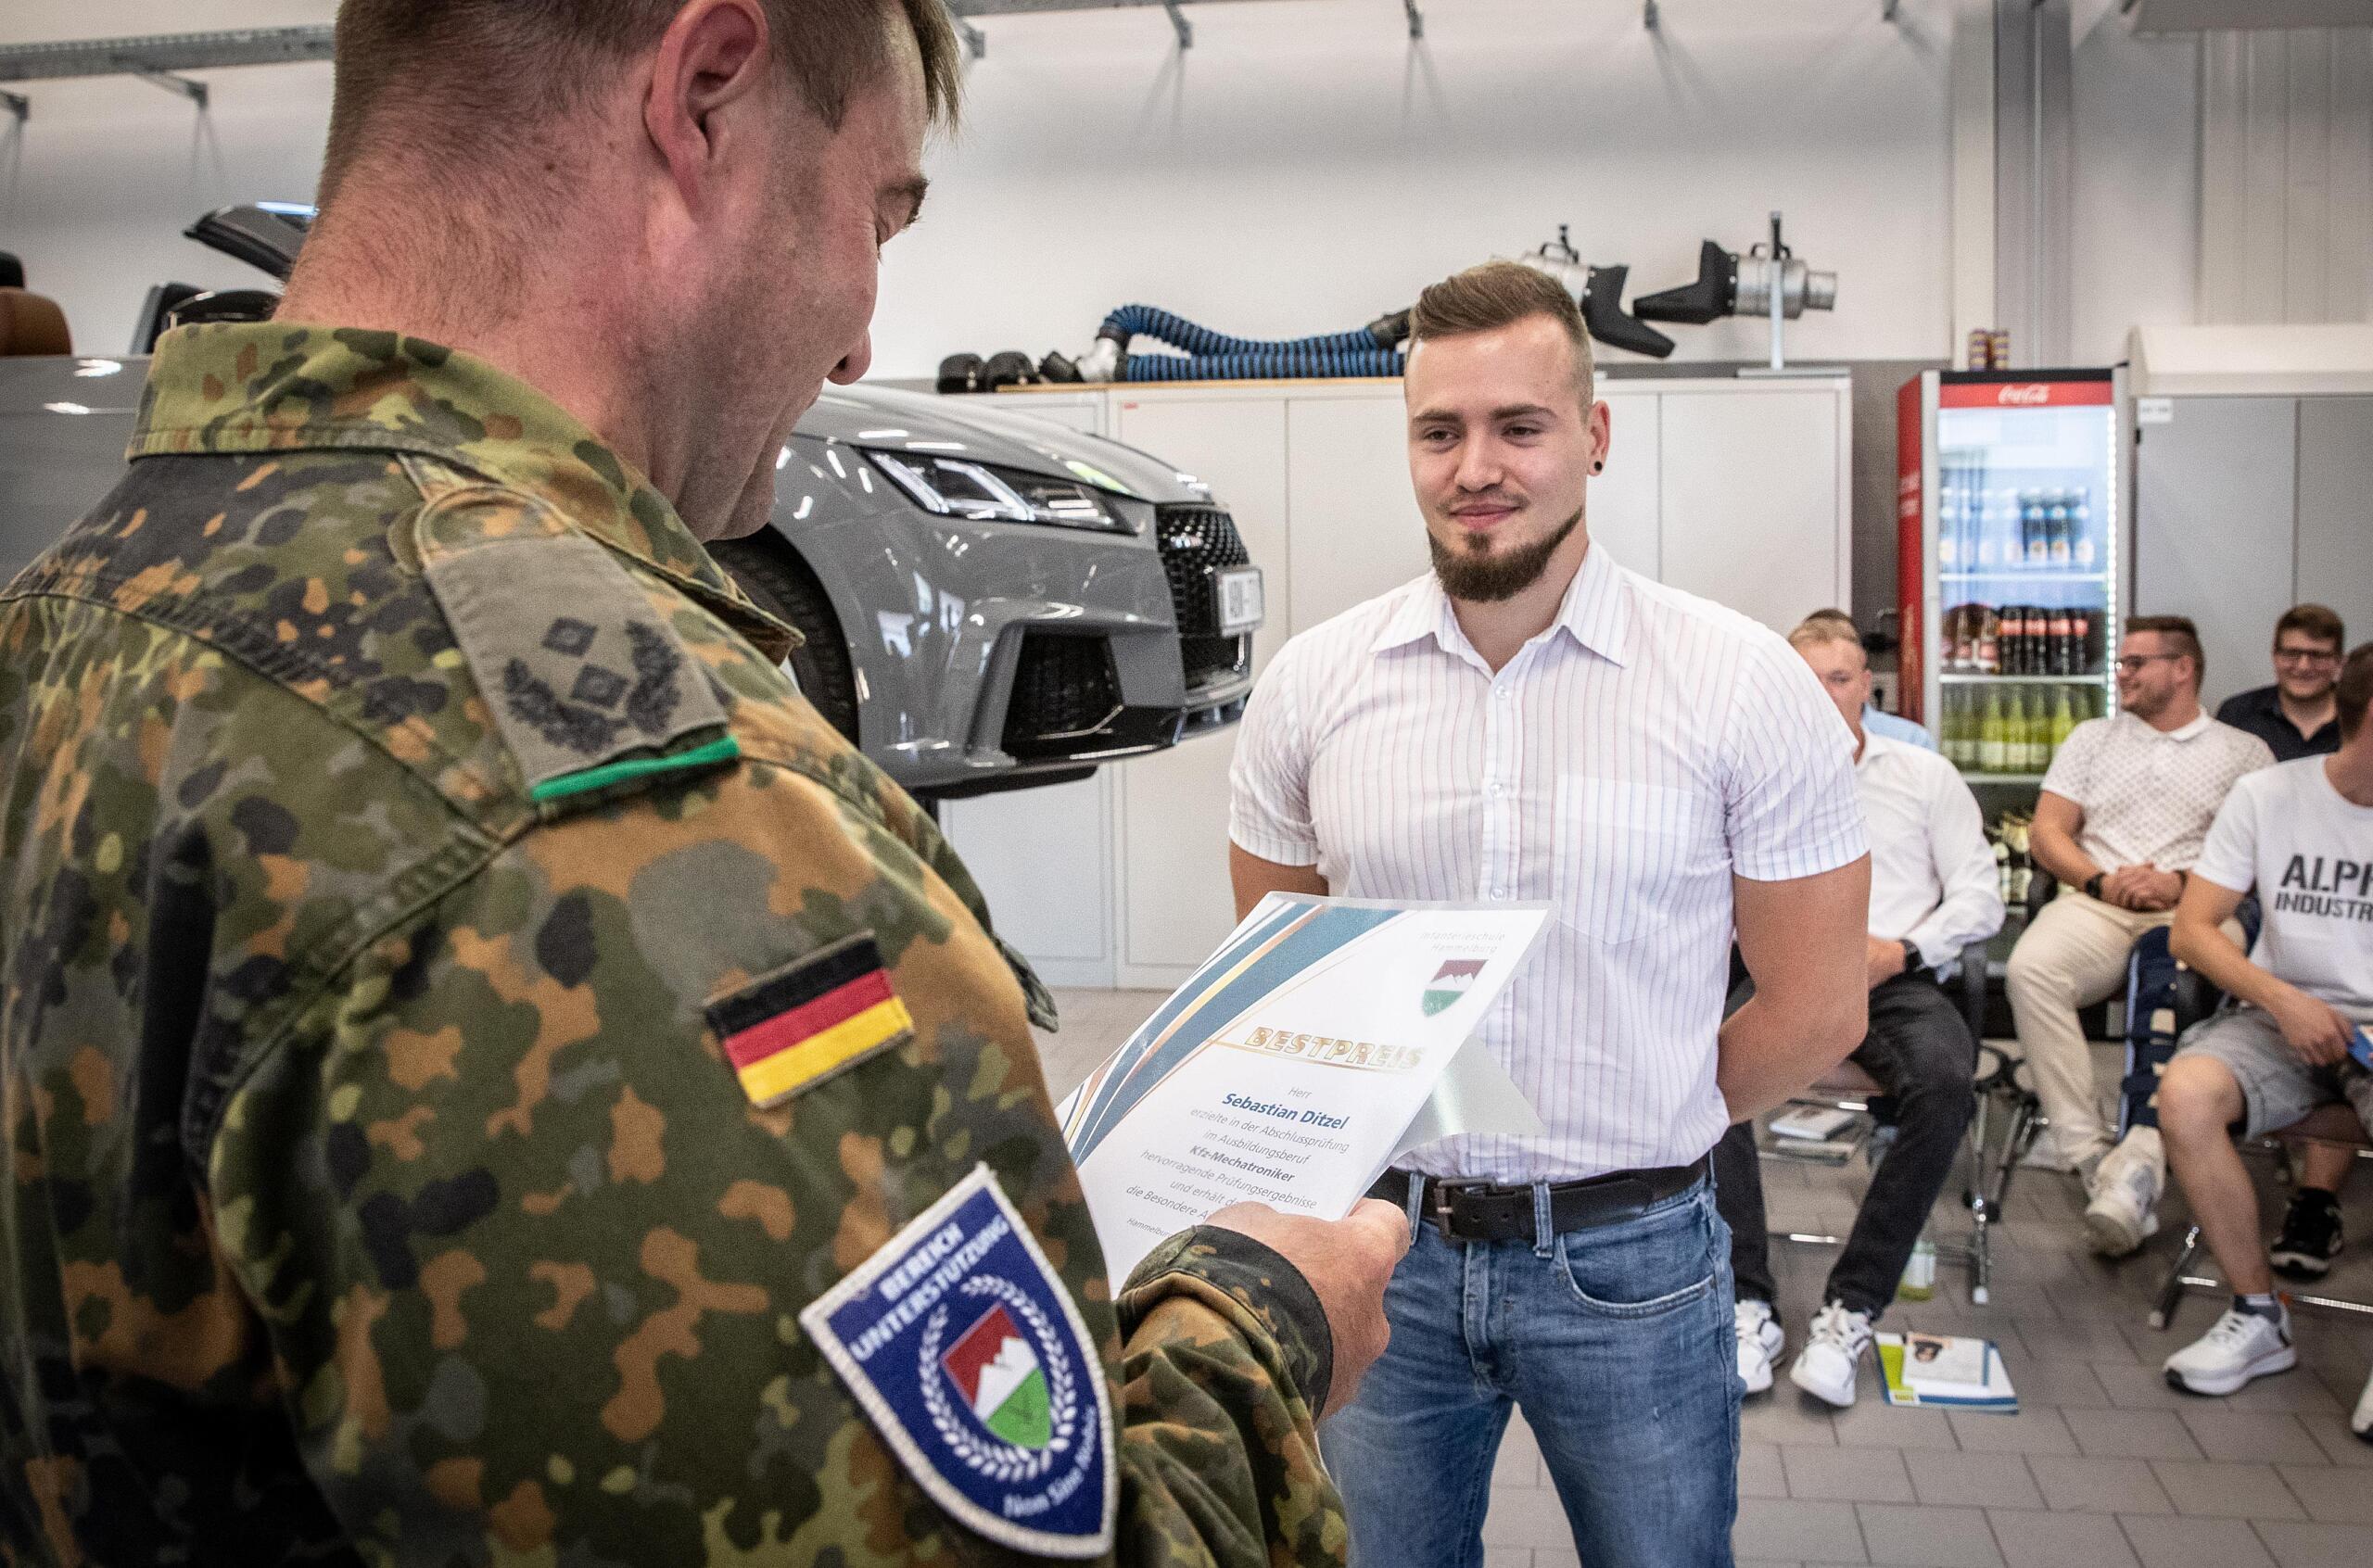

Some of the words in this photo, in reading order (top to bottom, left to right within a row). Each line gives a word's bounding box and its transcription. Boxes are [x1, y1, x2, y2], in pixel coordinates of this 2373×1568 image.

[1245, 1026, 1427, 1069] BESTPREIS
[1222, 1093, 1299, 1121] Sebastian
[1300, 1110, 1351, 1130] Ditzel
[1288, 1086, 1313, 1100] Herr
[1190, 1107, 1228, 1125] erzielte
[1228, 1117, 1240, 1129] in
[1240, 1119, 1261, 1132] der
[1261, 1125, 1350, 1155] Abschlussprüfung
[1202, 1130, 1218, 1140] im
[1218, 1133, 1312, 1166] Ausbildungsberuf
[1140, 1149, 1215, 1181] hervorragende
[1214, 1172, 1317, 1209] Prüfungsergebnisse
[1189, 1144, 1296, 1182] Kfz-Mechatroniker
[1126, 1185, 1144, 1197] die
[1143, 1191, 1199, 1216] Besondere
[1170, 1180, 1191, 1194] und
[1192, 1186, 1225, 1206] erhält
